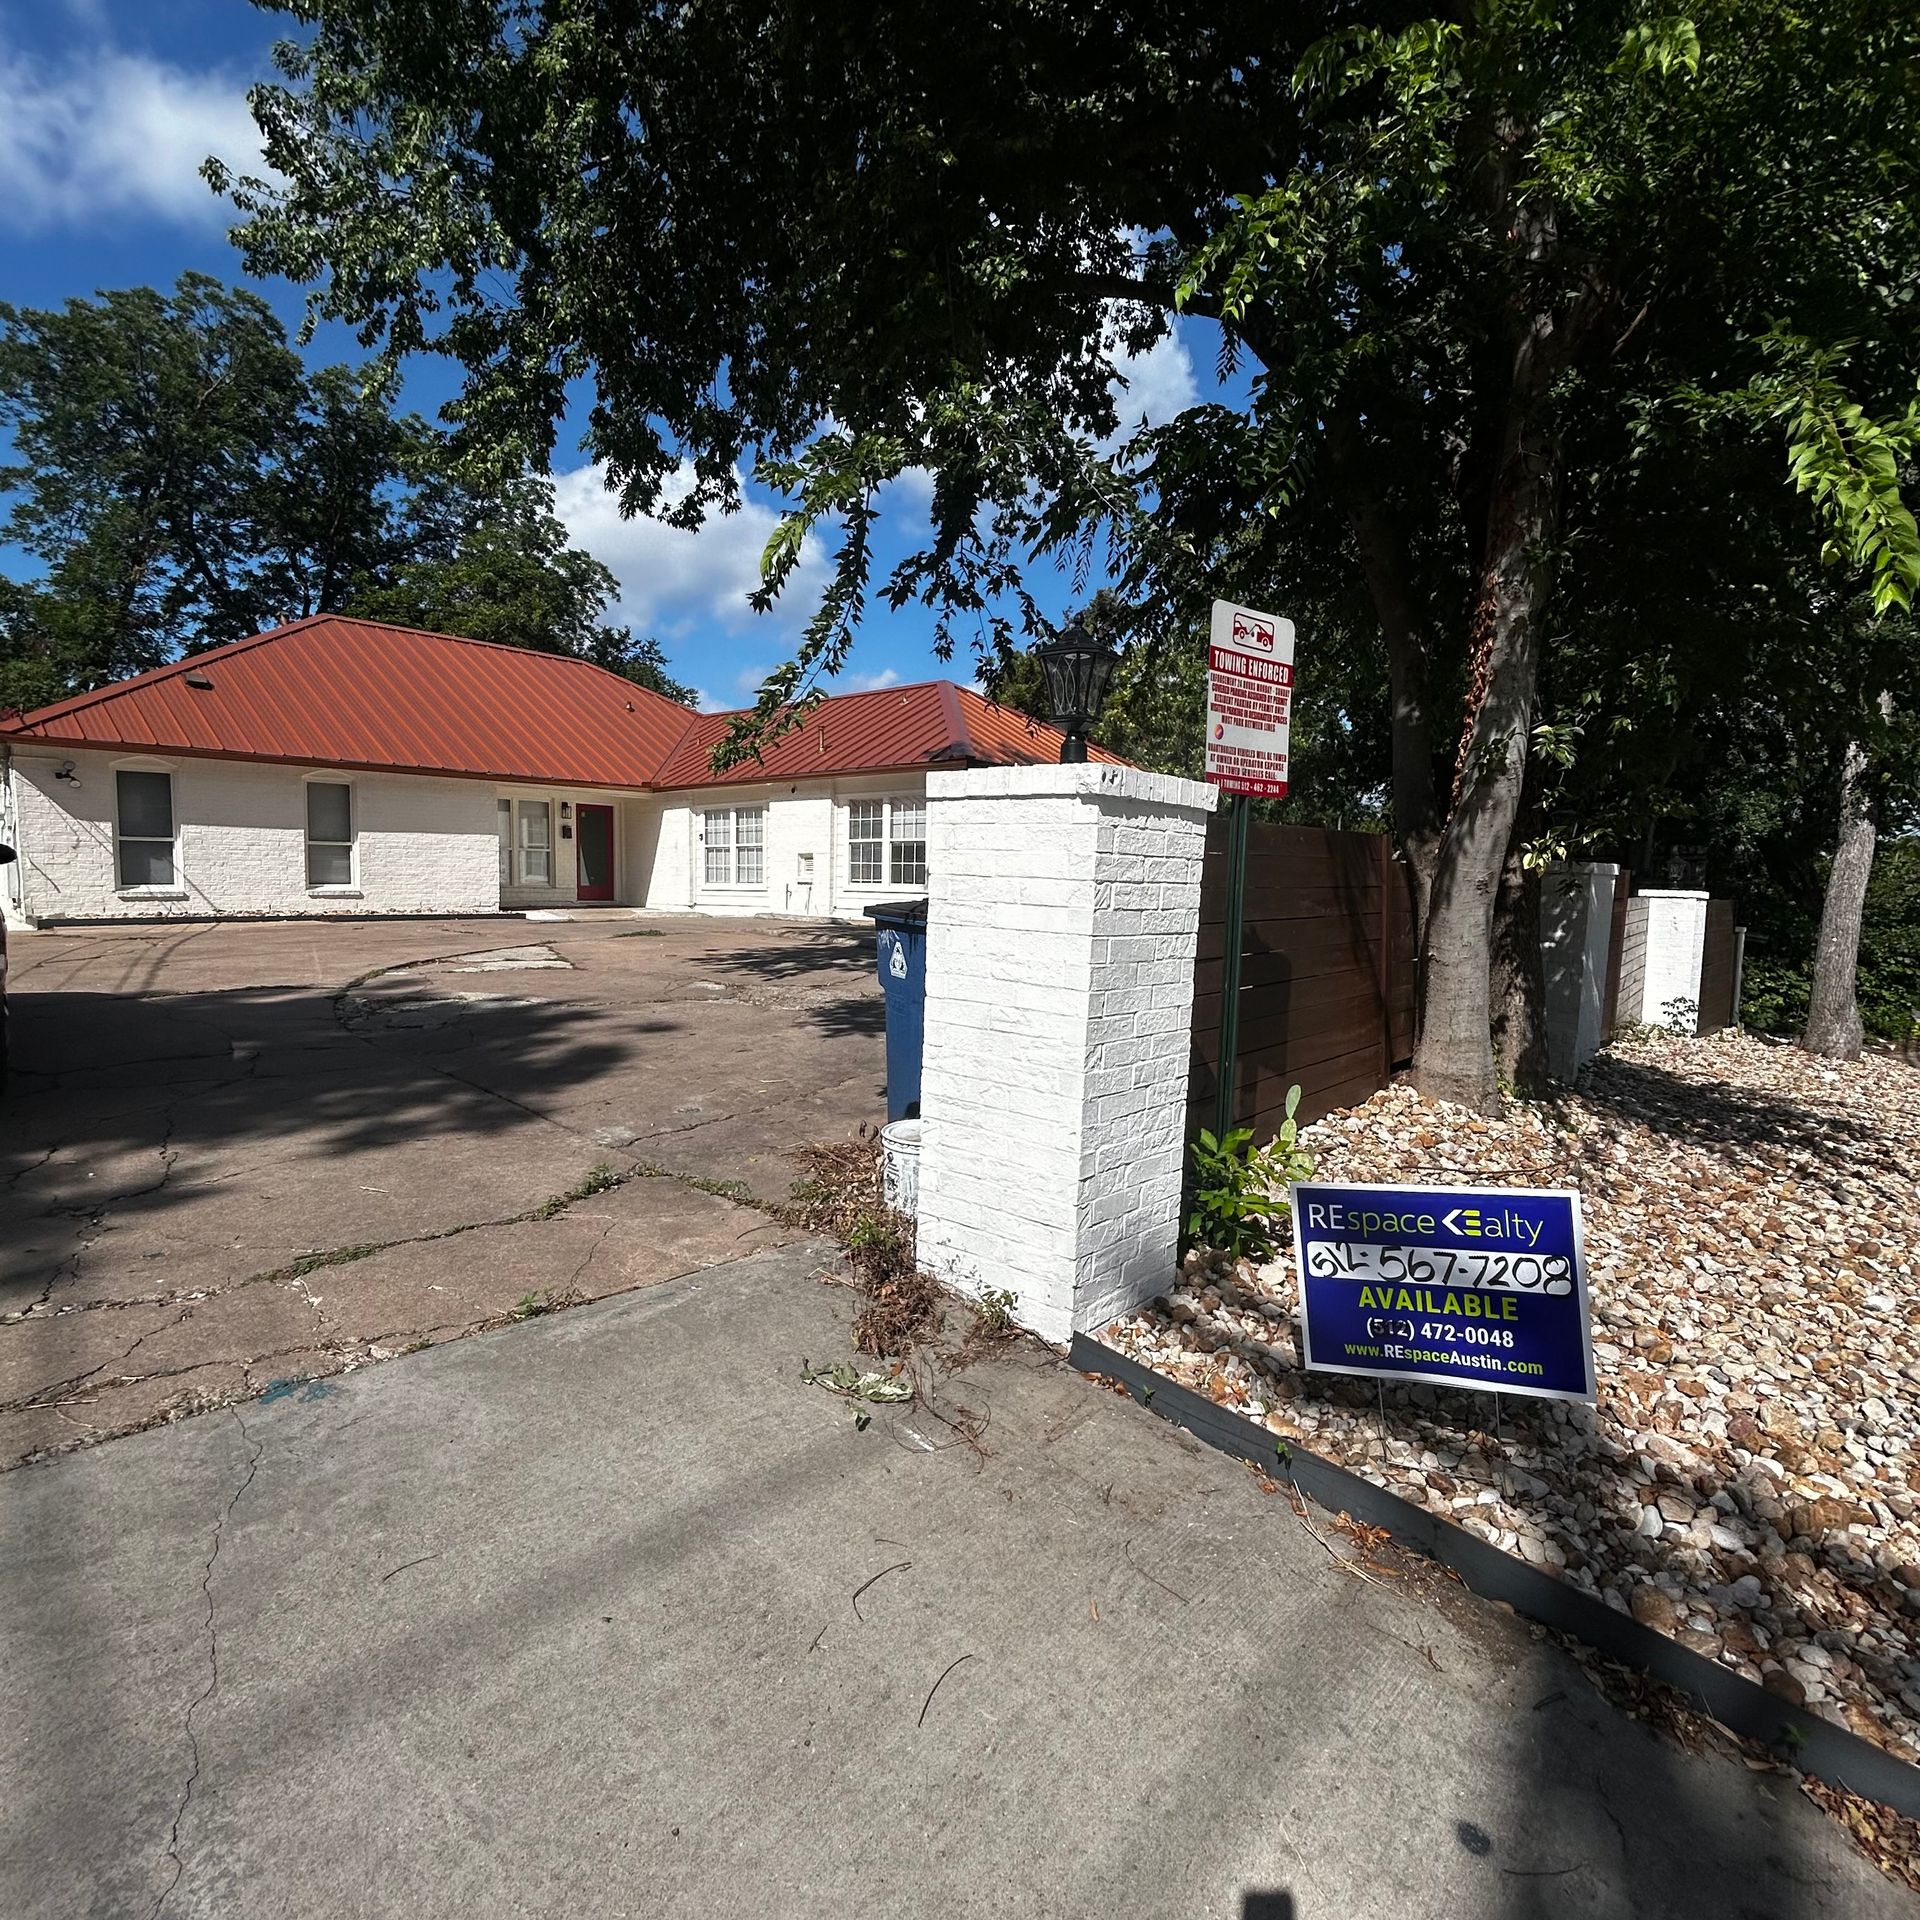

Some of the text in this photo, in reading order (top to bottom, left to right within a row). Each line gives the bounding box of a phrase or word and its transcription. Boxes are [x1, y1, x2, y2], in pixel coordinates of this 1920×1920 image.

[1214, 650, 1289, 683] TOWING ENFORCED
[1253, 701, 1258, 710] BY
[1259, 702, 1274, 713] PERMIT
[1233, 717, 1244, 727] PARK
[1210, 753, 1284, 771] AT OWNER OR OPERATOR EXPENSE
[1267, 752, 1272, 760] BE
[1273, 753, 1286, 762] TOWED
[1216, 764, 1224, 773] FOR
[1226, 765, 1240, 775] TOWED
[1241, 782, 1250, 791] 512
[1254, 783, 1263, 792] 462
[1267, 784, 1279, 794] 2244
[1308, 1203, 1435, 1239] REspace
[1358, 1286, 1519, 1321] AVAILABLE
[1366, 1317, 1514, 1348] (512) 472-0048
[1344, 1343, 1543, 1375] www.REspaceAustin.com
